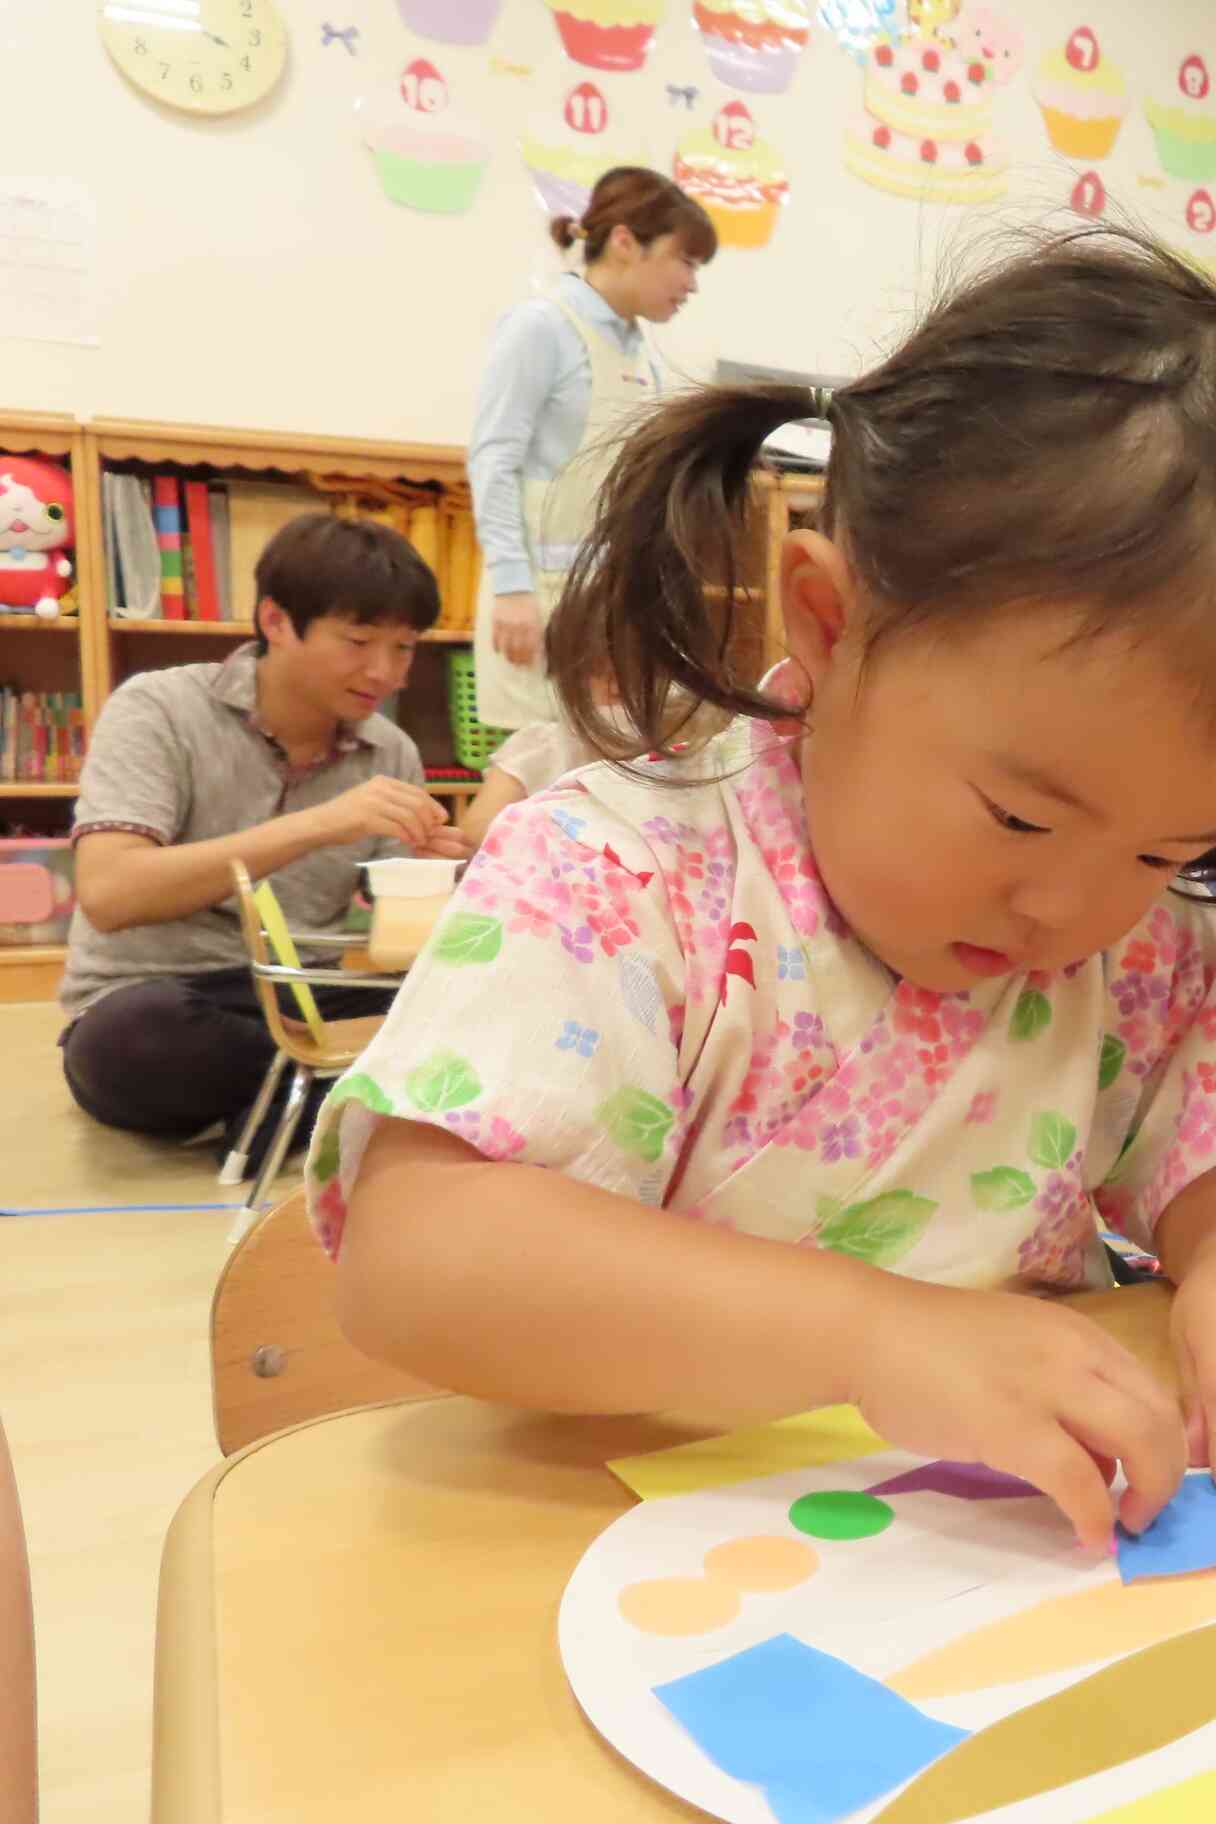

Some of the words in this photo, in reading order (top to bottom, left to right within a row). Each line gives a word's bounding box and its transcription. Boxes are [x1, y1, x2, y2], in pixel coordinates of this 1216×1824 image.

[240, 0, 253, 18] 2
[248, 29, 262, 47] 3
[1074, 35, 1094, 68] 7
[159, 61, 171, 80] 7
[239, 55, 251, 72] 4
[189, 73, 204, 93] 6
[219, 72, 233, 91] 5
